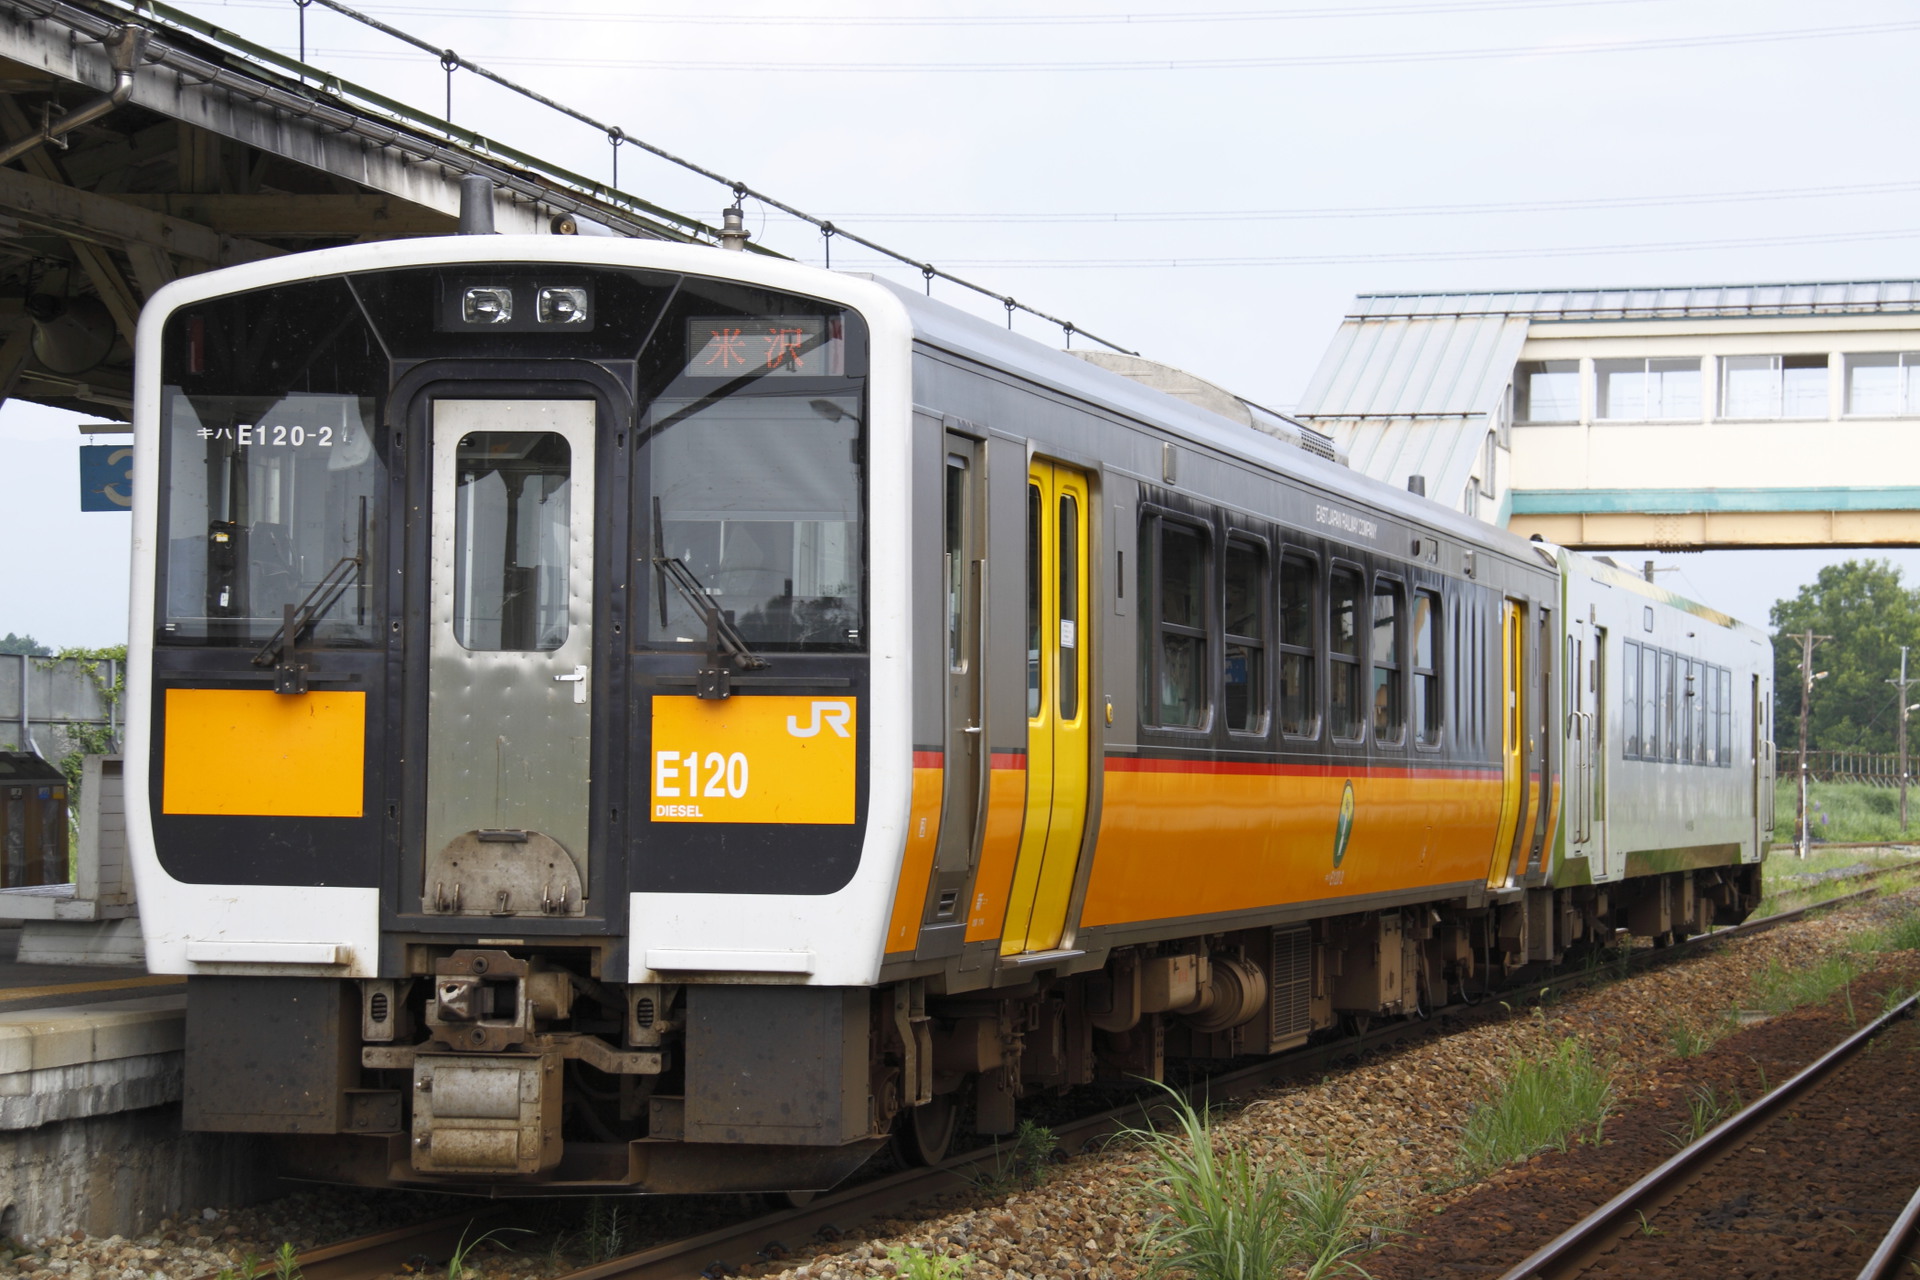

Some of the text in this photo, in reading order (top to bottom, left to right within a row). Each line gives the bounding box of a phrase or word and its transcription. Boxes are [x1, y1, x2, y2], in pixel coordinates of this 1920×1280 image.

[705, 328, 804, 368] 米沢
[1316, 505, 1378, 539] EAST JAPAN RAILWAY COMPANY
[787, 701, 851, 738] JR
[656, 751, 749, 799] E120
[656, 805, 703, 817] DIESEL
